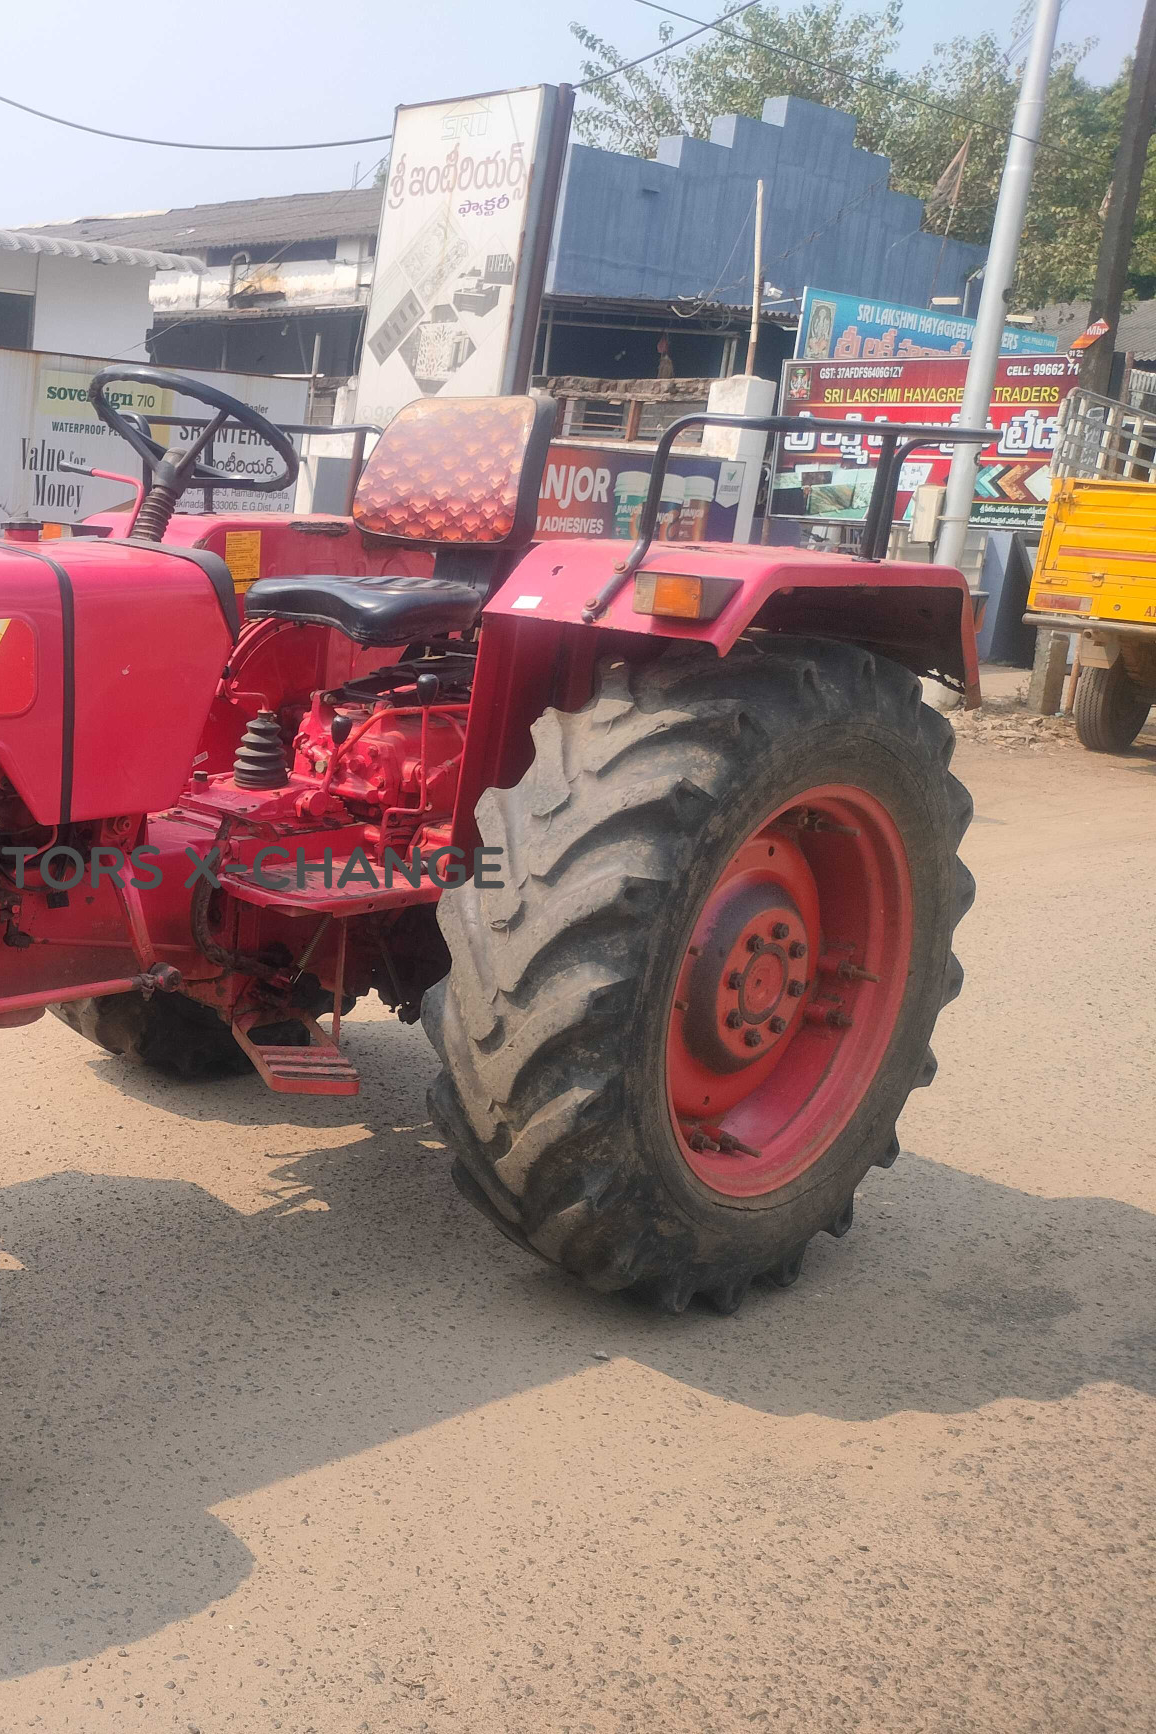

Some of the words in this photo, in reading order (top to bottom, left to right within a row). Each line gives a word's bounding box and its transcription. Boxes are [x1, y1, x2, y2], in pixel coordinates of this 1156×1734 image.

[857, 304, 873, 323] SRI
[1007, 366, 1031, 376] CELL:
[1033, 363, 1064, 376] 99662
[1067, 363, 1082, 376] 71
[137, 394, 155, 408] 710
[824, 388, 844, 403] SRI
[846, 388, 901, 403] LAKSHMI
[904, 387, 965, 403] HAYAGRE
[994, 386, 1060, 402] TRADERS
[51, 421, 106, 436] WATERPROOF
[21, 437, 65, 472] Value
[33, 474, 84, 515] Money
[543, 516, 604, 535] ADHESIVES
